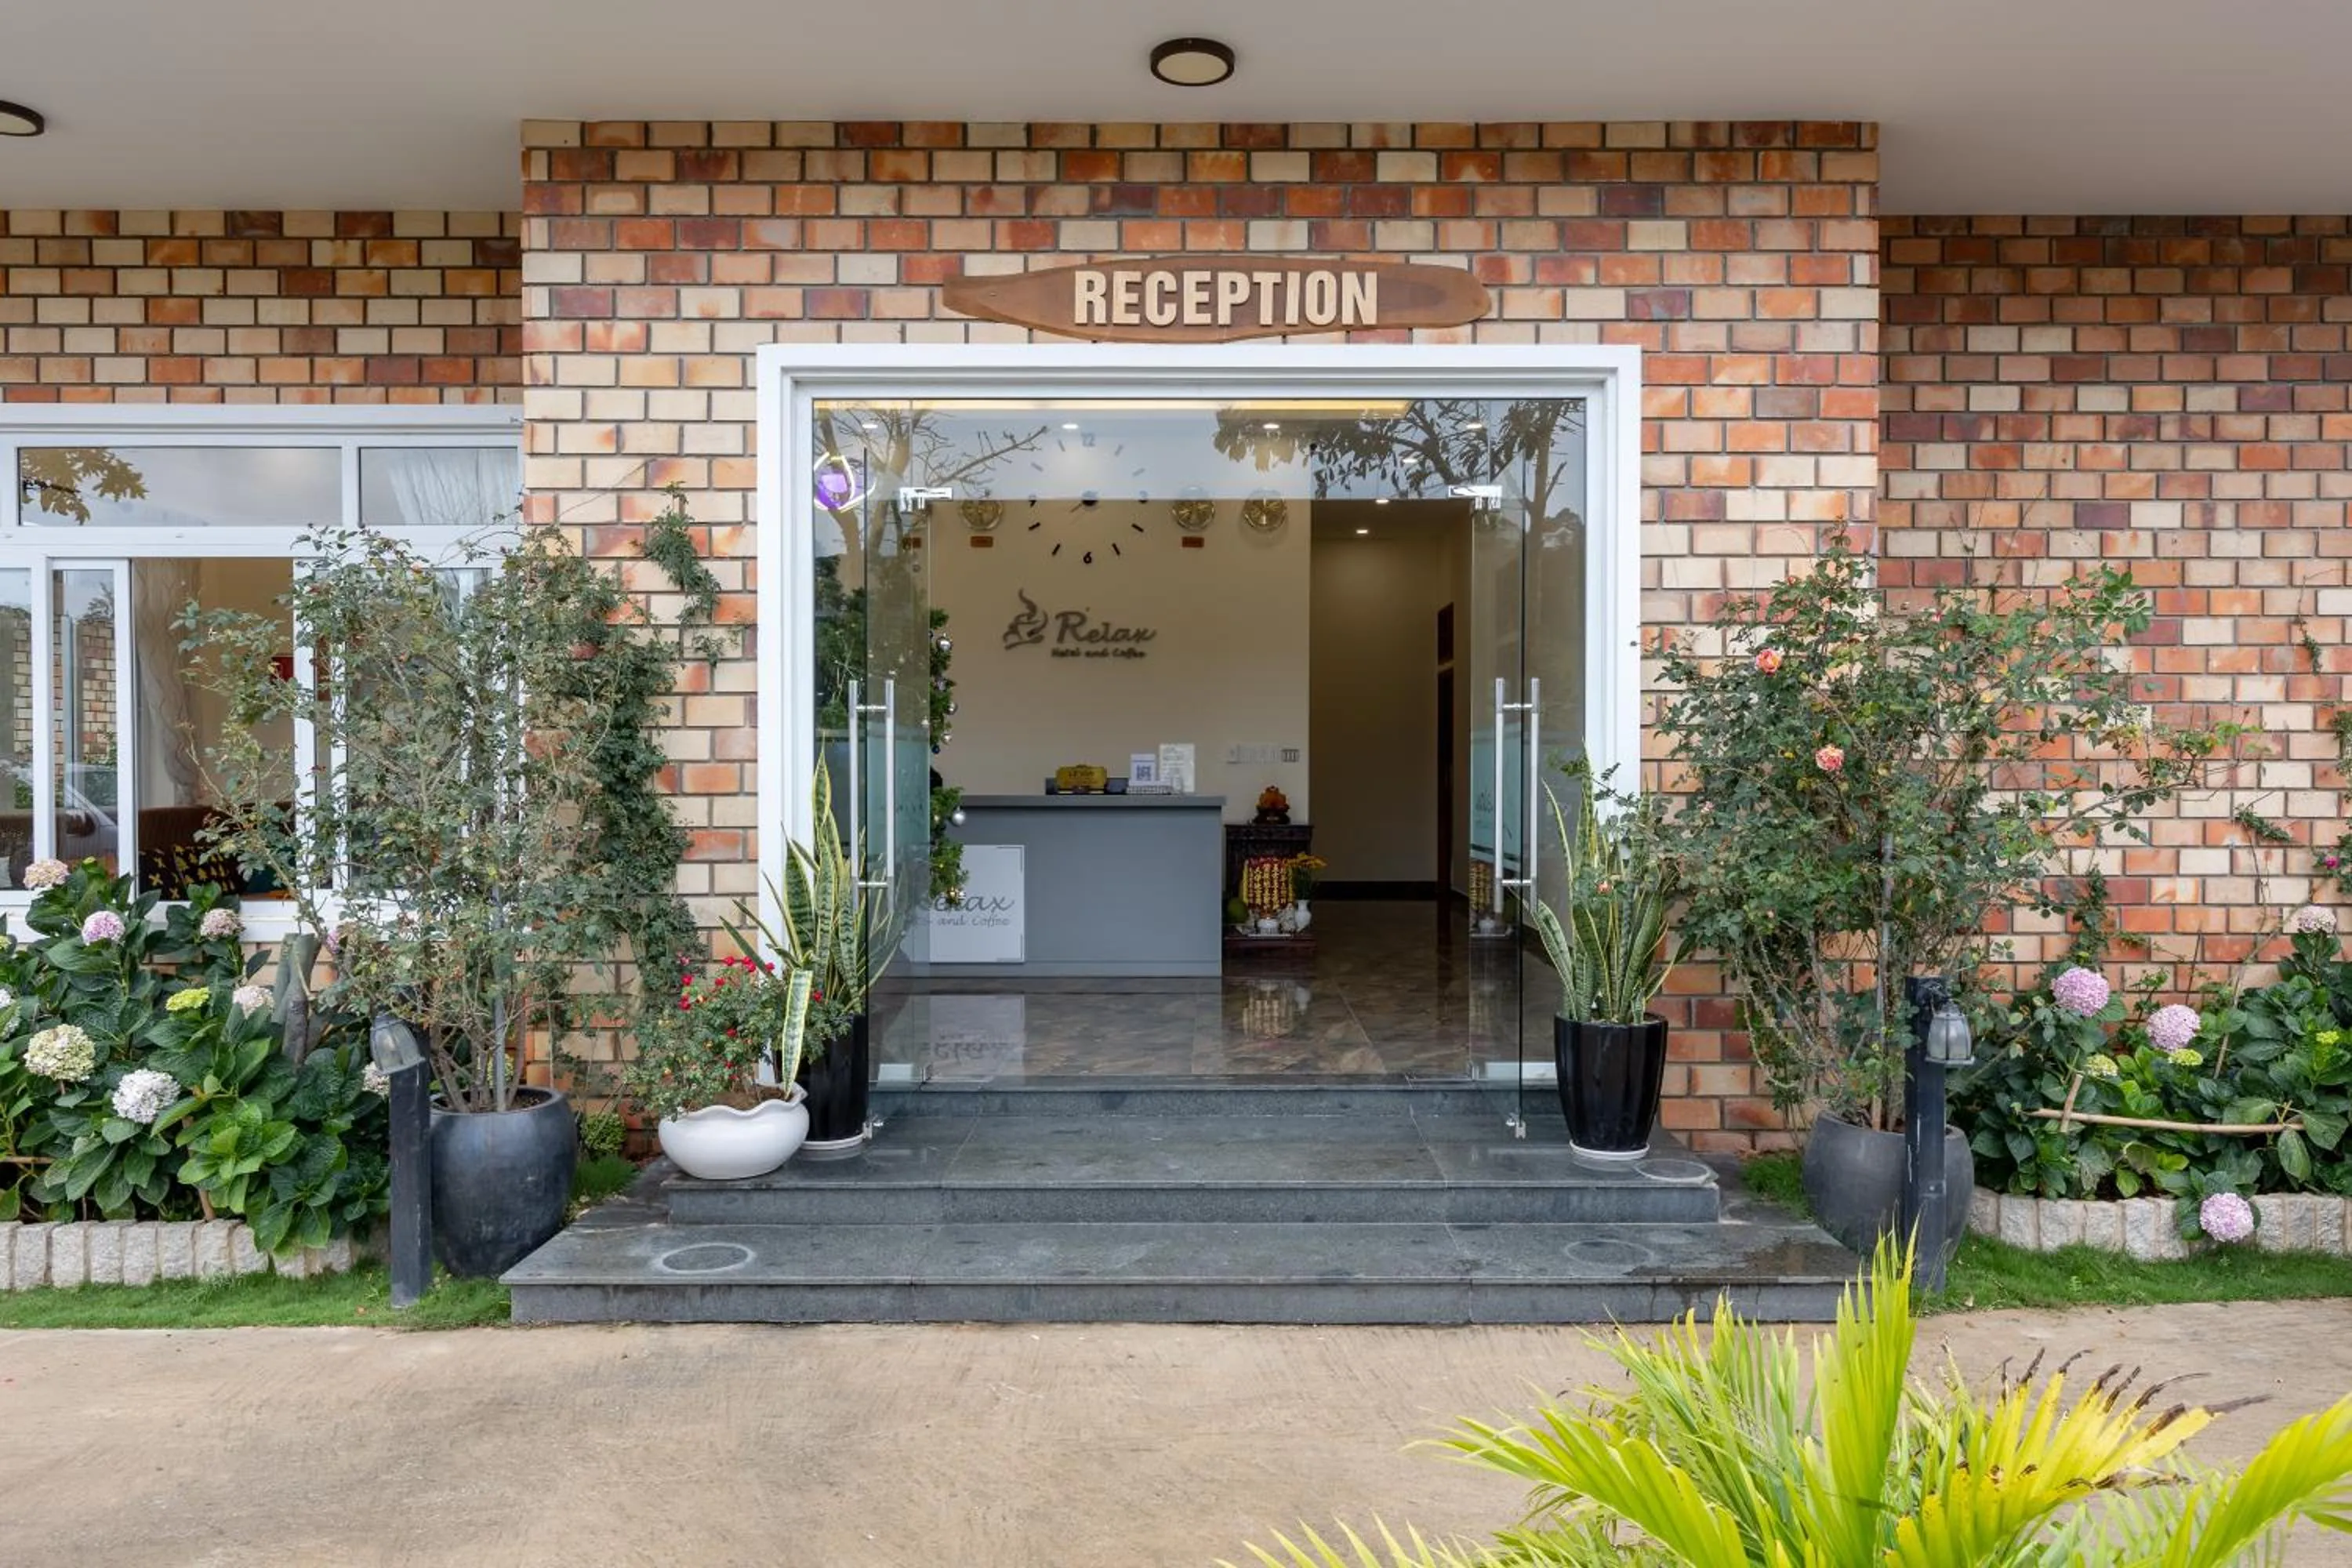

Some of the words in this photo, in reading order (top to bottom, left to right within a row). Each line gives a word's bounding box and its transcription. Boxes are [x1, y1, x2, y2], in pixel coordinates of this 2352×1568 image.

[1073, 270, 1377, 327] RECEPTION
[1081, 432, 1095, 447] 12
[1083, 551, 1092, 564] 6
